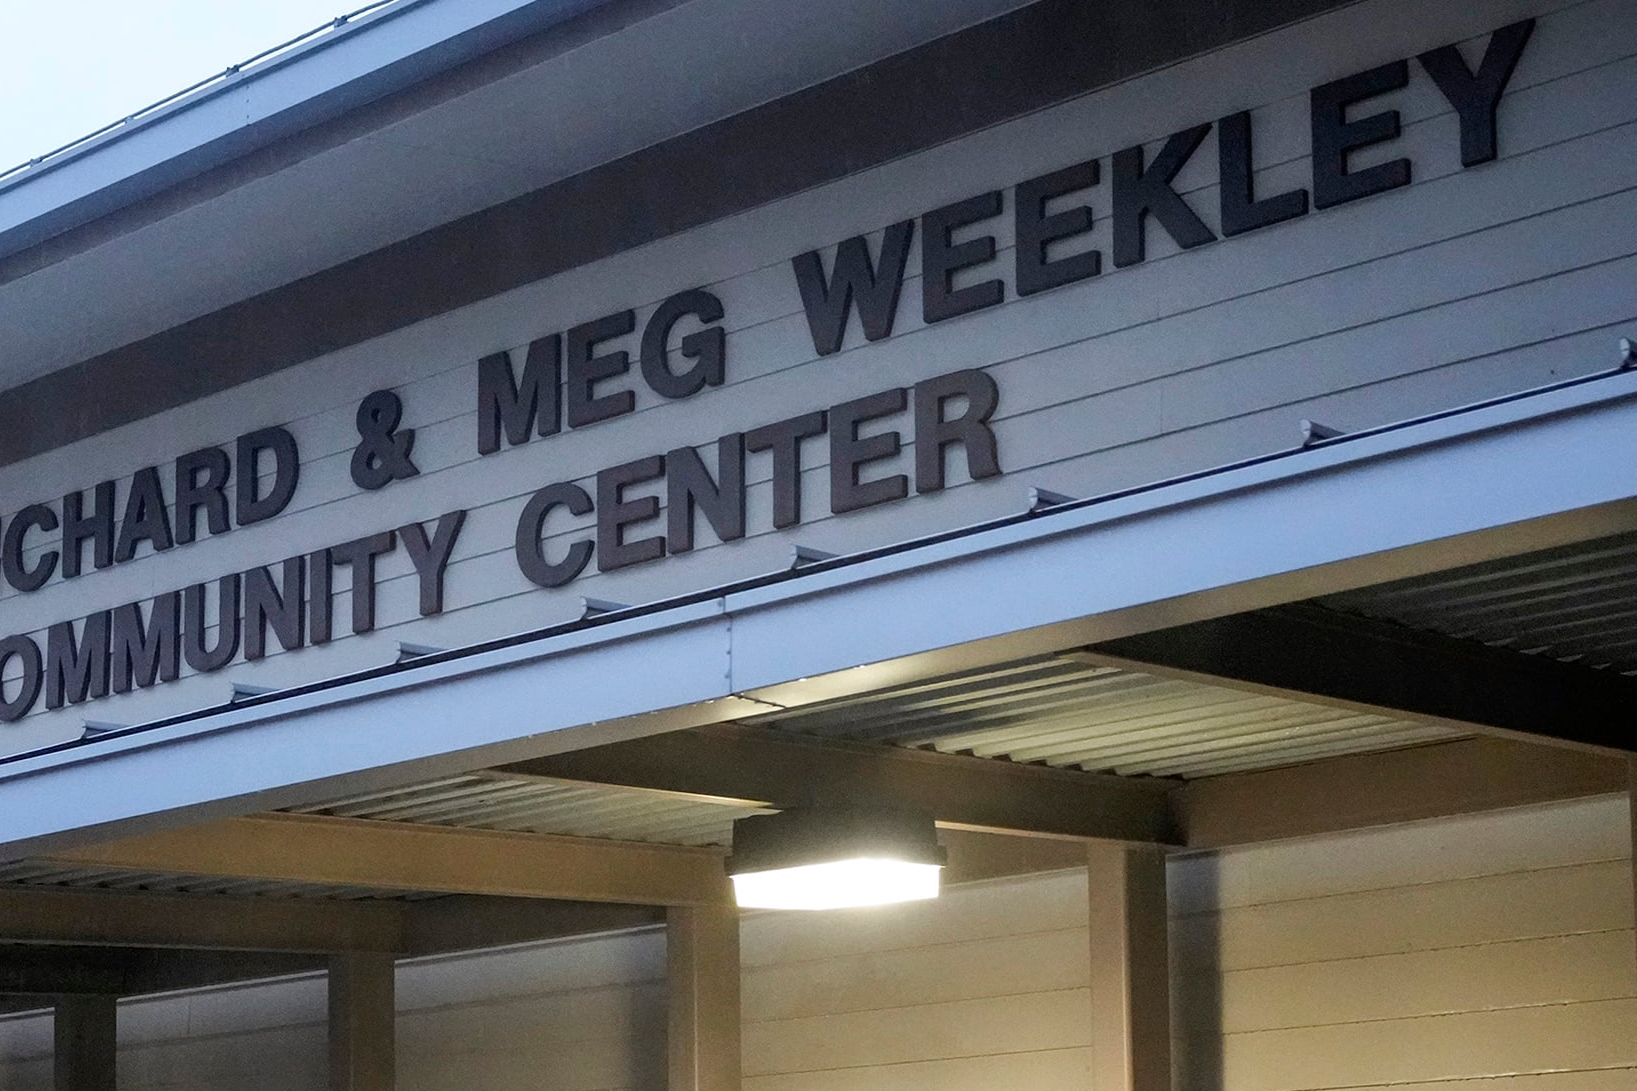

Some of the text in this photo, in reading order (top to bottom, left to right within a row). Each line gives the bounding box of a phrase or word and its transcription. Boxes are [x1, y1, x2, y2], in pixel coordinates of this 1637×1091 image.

[350, 389, 421, 490] &
[477, 288, 727, 456] MEG
[791, 18, 1537, 357] WEEKLEY
[515, 367, 1004, 589] CENTER
